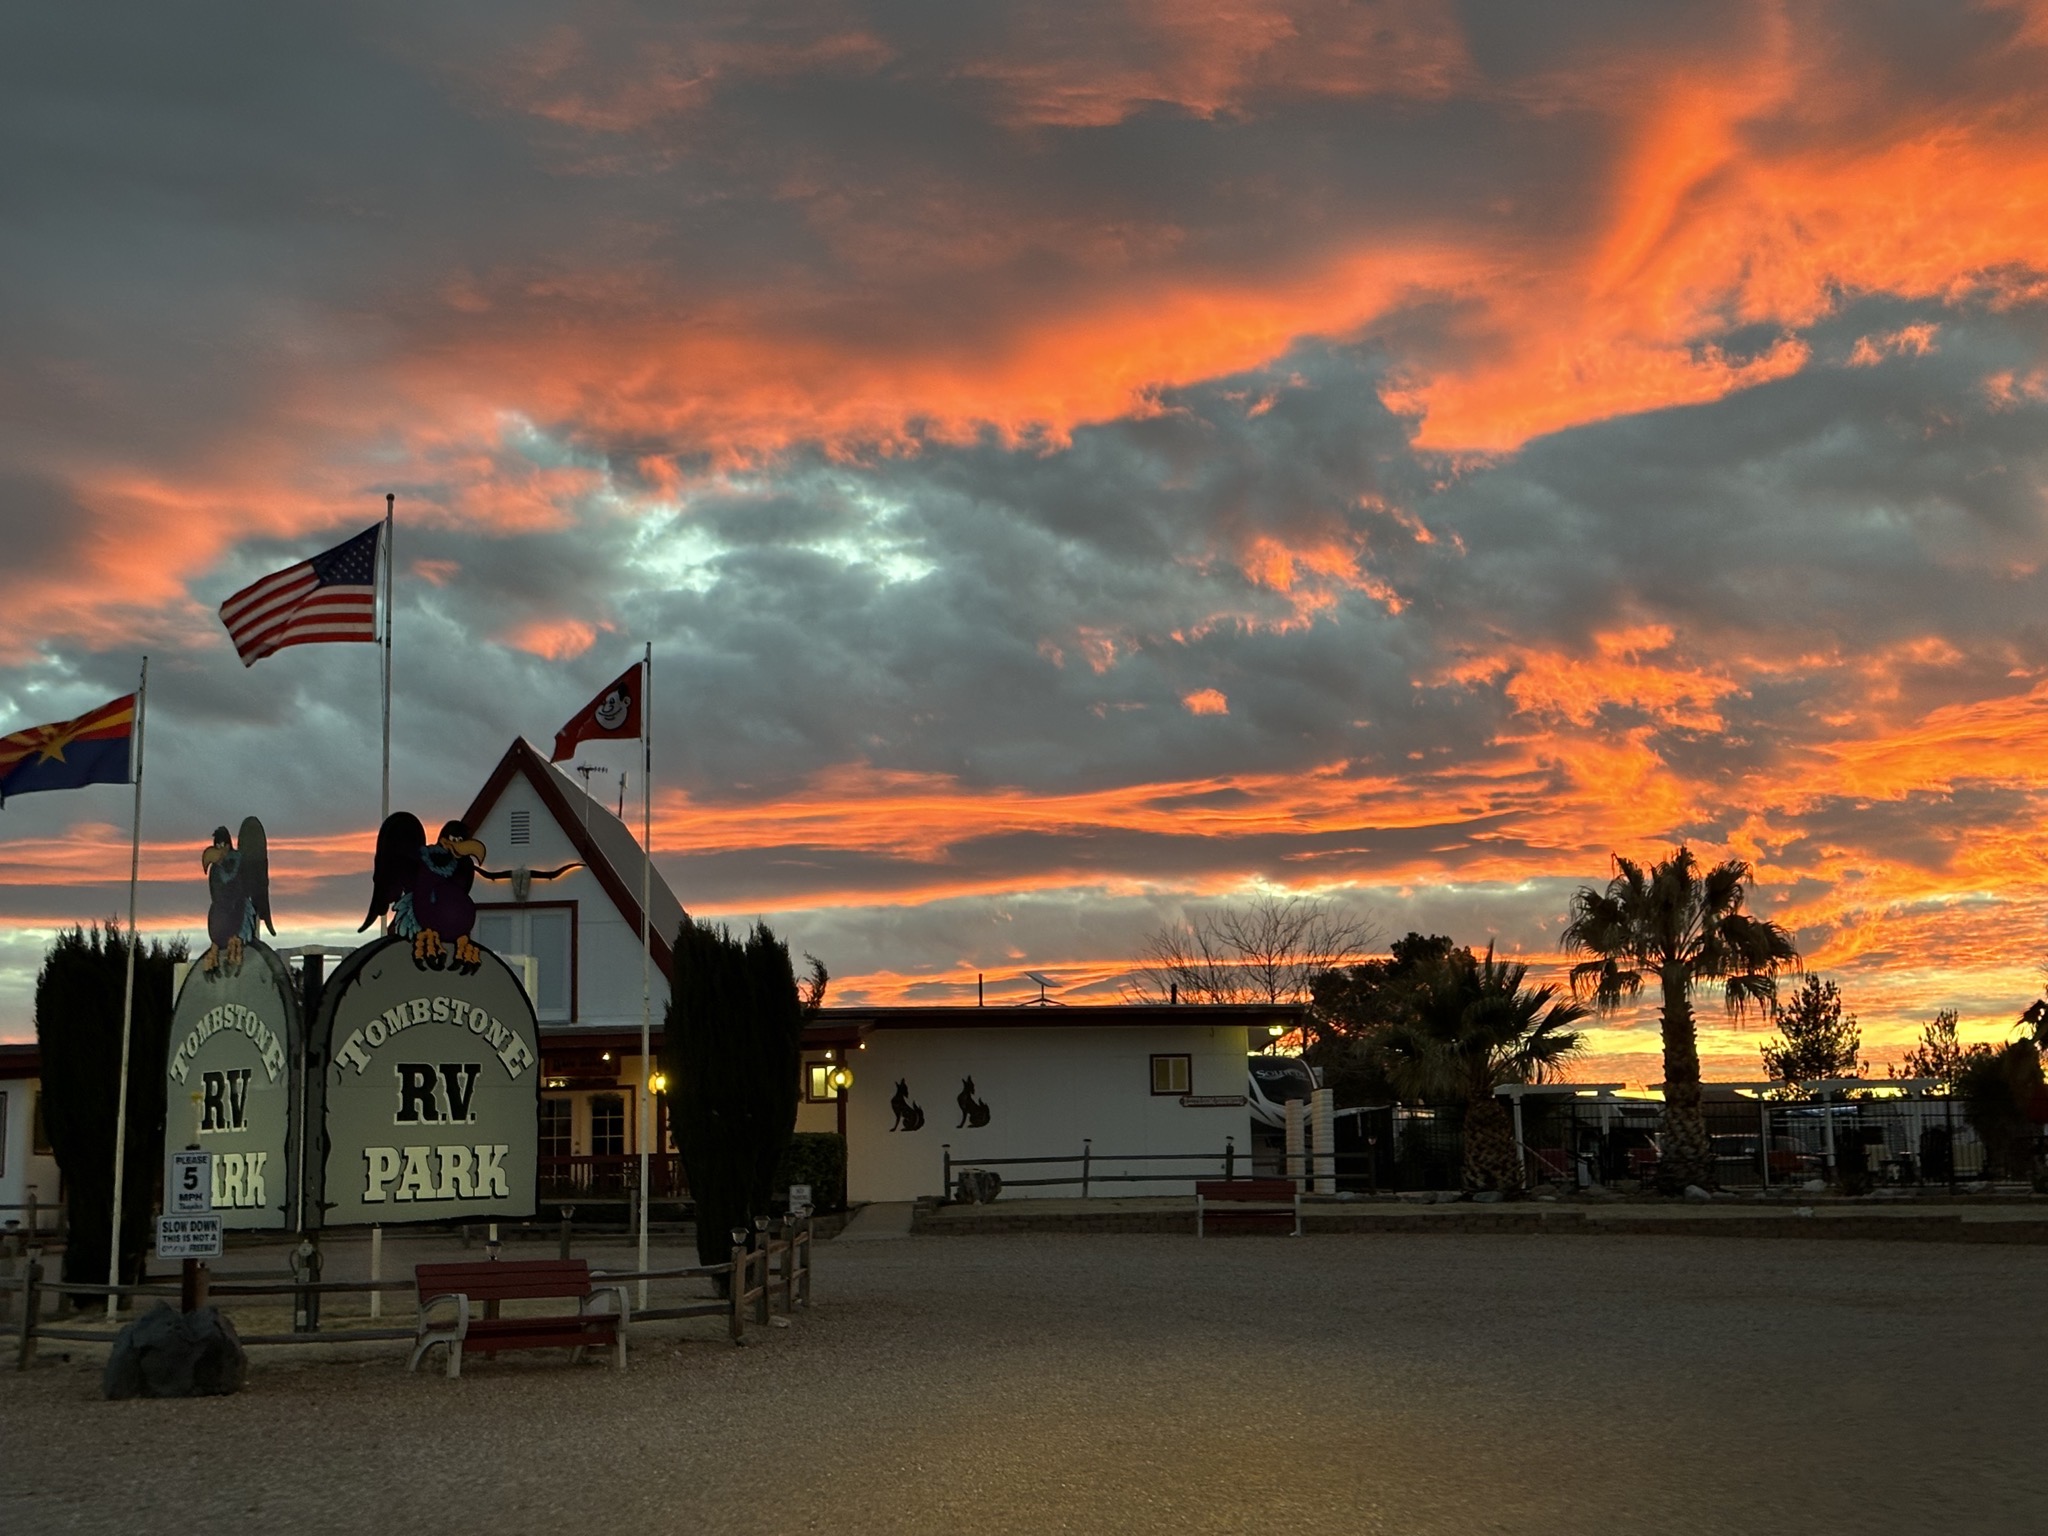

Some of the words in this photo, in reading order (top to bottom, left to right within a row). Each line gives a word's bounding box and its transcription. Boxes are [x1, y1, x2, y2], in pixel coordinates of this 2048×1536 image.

[170, 1003, 286, 1086] TOMBSTONE
[335, 996, 534, 1080] TOMBSTONE
[176, 1156, 208, 1165] PLEASE
[183, 1167, 198, 1190] 5
[211, 1152, 267, 1208] RK
[362, 1145, 510, 1203] PARK
[179, 1193, 203, 1201] MPH
[162, 1221, 188, 1232] SLOW
[190, 1220, 217, 1231] DOWN
[162, 1234, 181, 1242] THIS
[183, 1234, 191, 1242] IS
[193, 1233, 209, 1242] NOT
[211, 1233, 217, 1241] A
